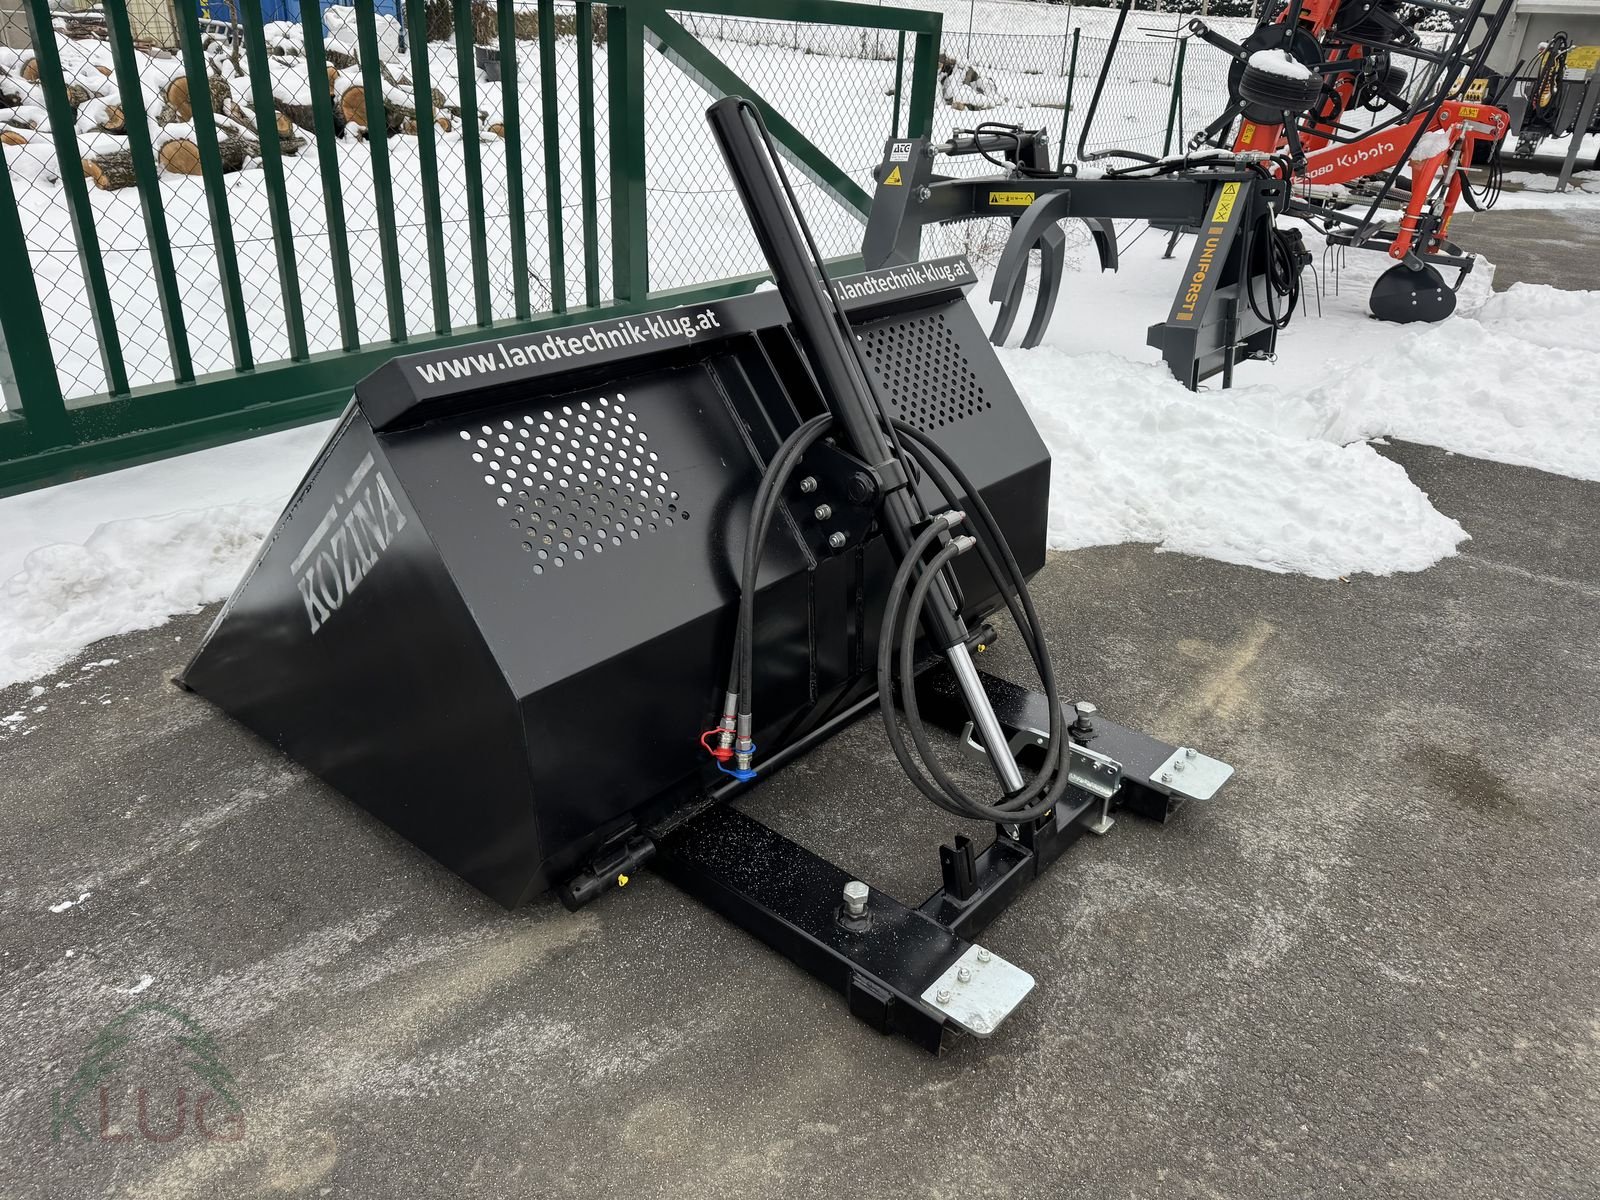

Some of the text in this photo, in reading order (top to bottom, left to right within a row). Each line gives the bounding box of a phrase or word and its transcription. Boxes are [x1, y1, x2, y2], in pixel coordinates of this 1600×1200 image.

[1337, 142, 1395, 167] Kubota
[1183, 238, 1219, 311] UNIFORST
[416, 308, 720, 384] www.landtechnik-klug.at
[297, 472, 407, 634] KOZINA
